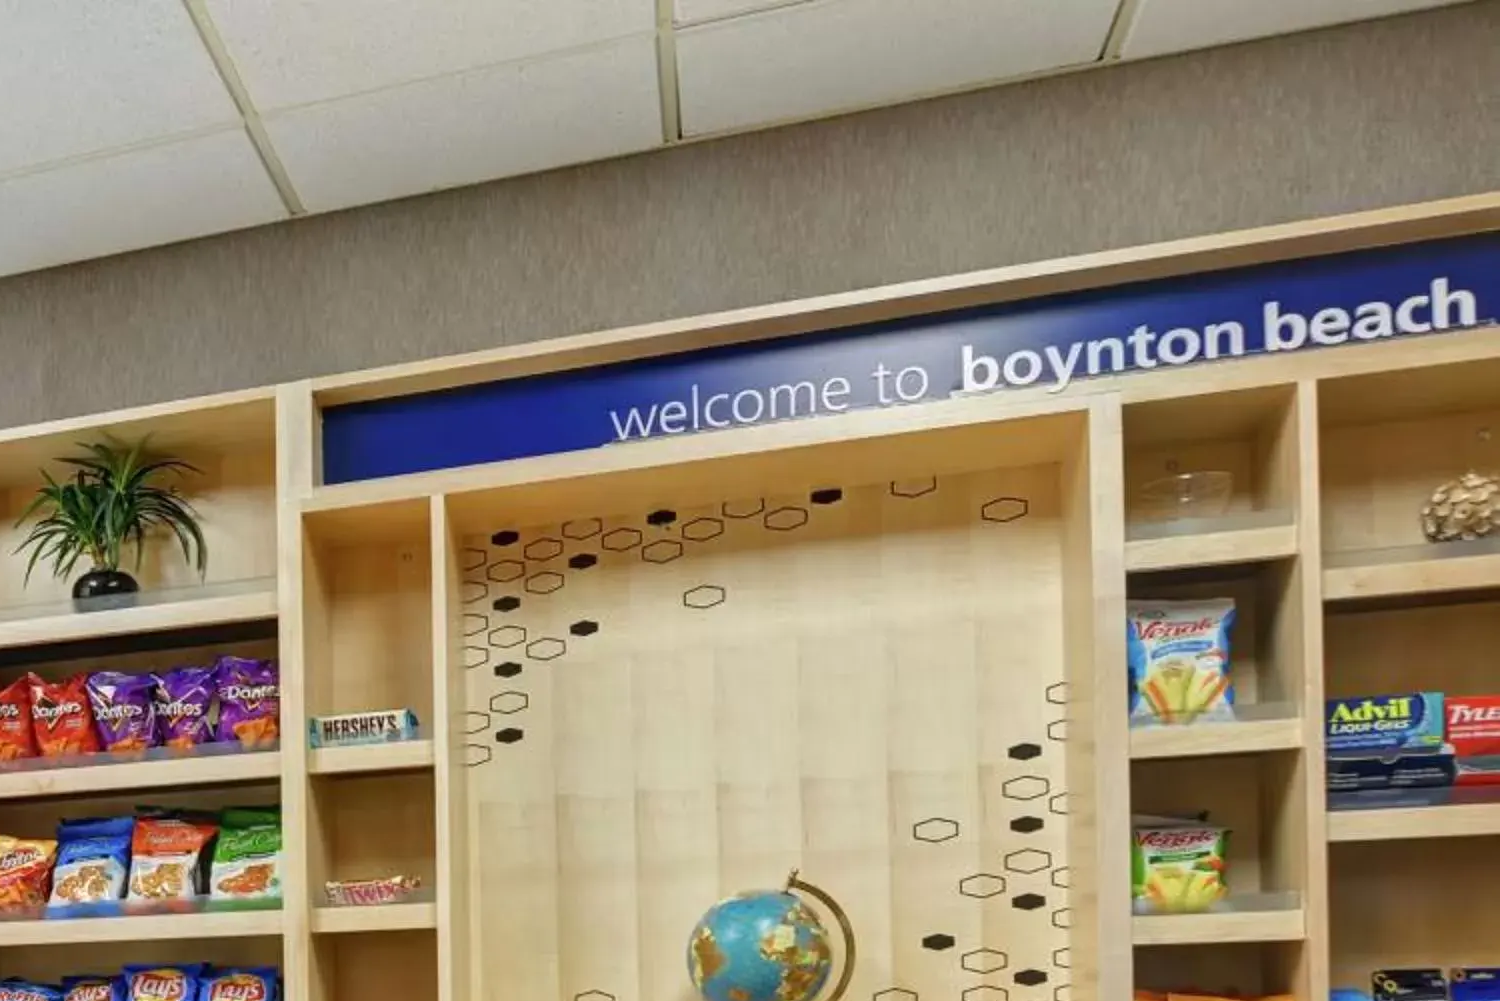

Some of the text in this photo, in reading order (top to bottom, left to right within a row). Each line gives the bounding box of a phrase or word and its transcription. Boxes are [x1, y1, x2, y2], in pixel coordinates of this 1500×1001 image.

[609, 276, 1478, 443] welcome to boynton beach
[1330, 697, 1412, 722] Advil
